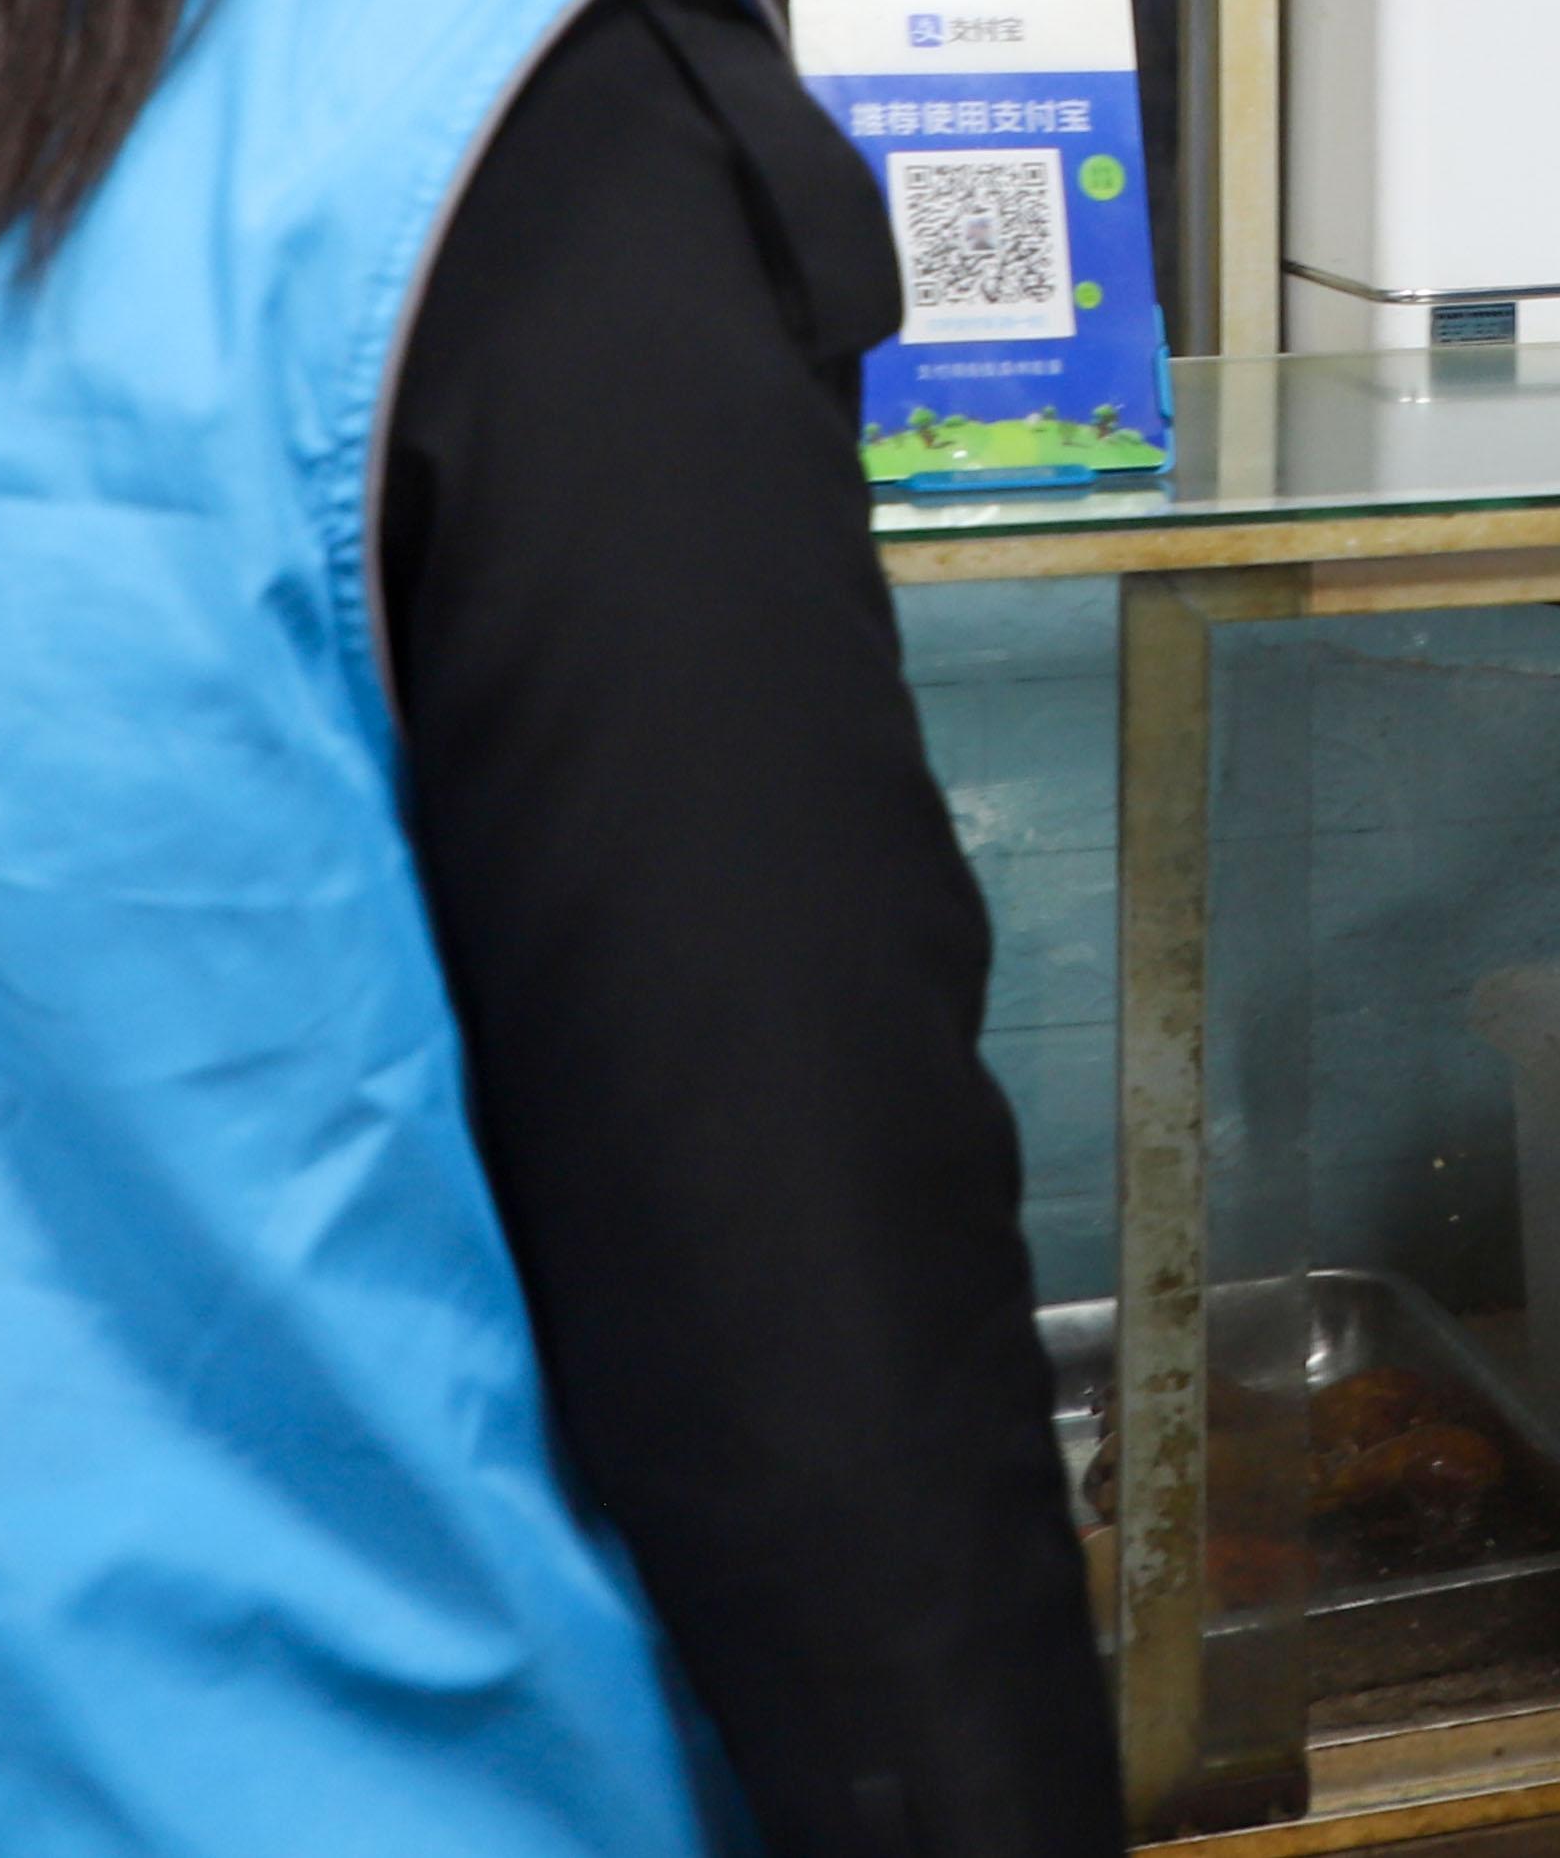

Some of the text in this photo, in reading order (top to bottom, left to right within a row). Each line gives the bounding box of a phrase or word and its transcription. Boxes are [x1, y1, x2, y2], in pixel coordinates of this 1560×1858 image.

[851, 98, 1093, 138] 推荐使用支付宝
